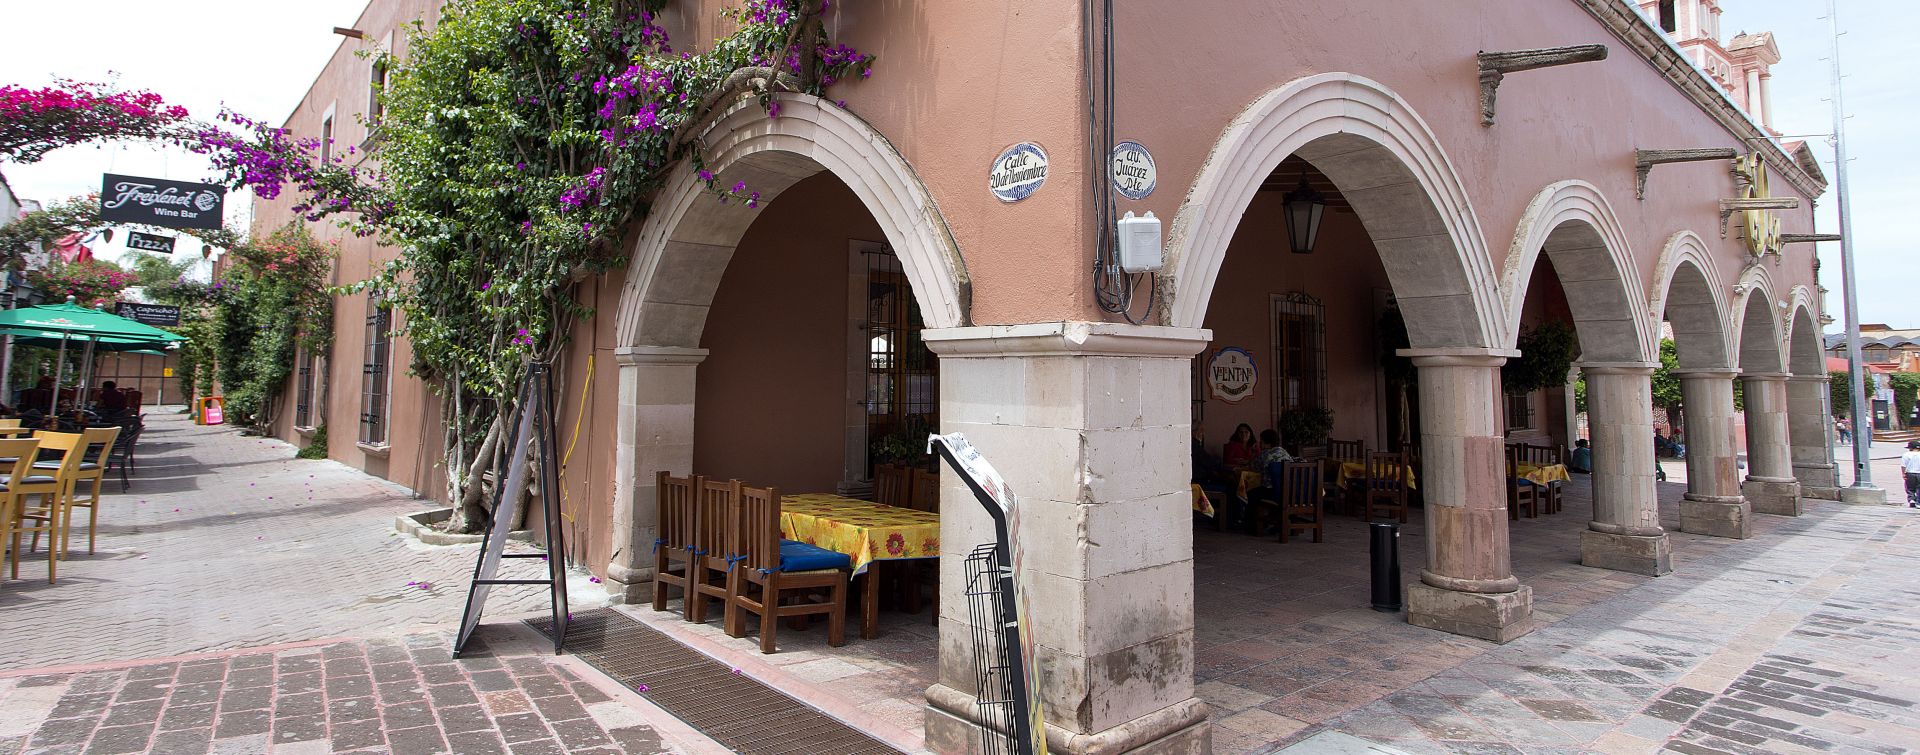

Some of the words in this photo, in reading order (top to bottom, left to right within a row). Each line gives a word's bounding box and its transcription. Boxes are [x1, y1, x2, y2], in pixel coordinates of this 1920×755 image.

[1004, 151, 1029, 171] Calle
[1115, 158, 1148, 179] Juárez
[990, 172, 1001, 189] 20
[1000, 170, 1009, 187] de
[1008, 162, 1047, 185] Noviembre
[1124, 177, 1144, 191] Pte.
[104, 181, 196, 209] Freixenet
[154, 207, 179, 216] Wine
[180, 209, 198, 219] Bar
[129, 233, 171, 252] PIZZA
